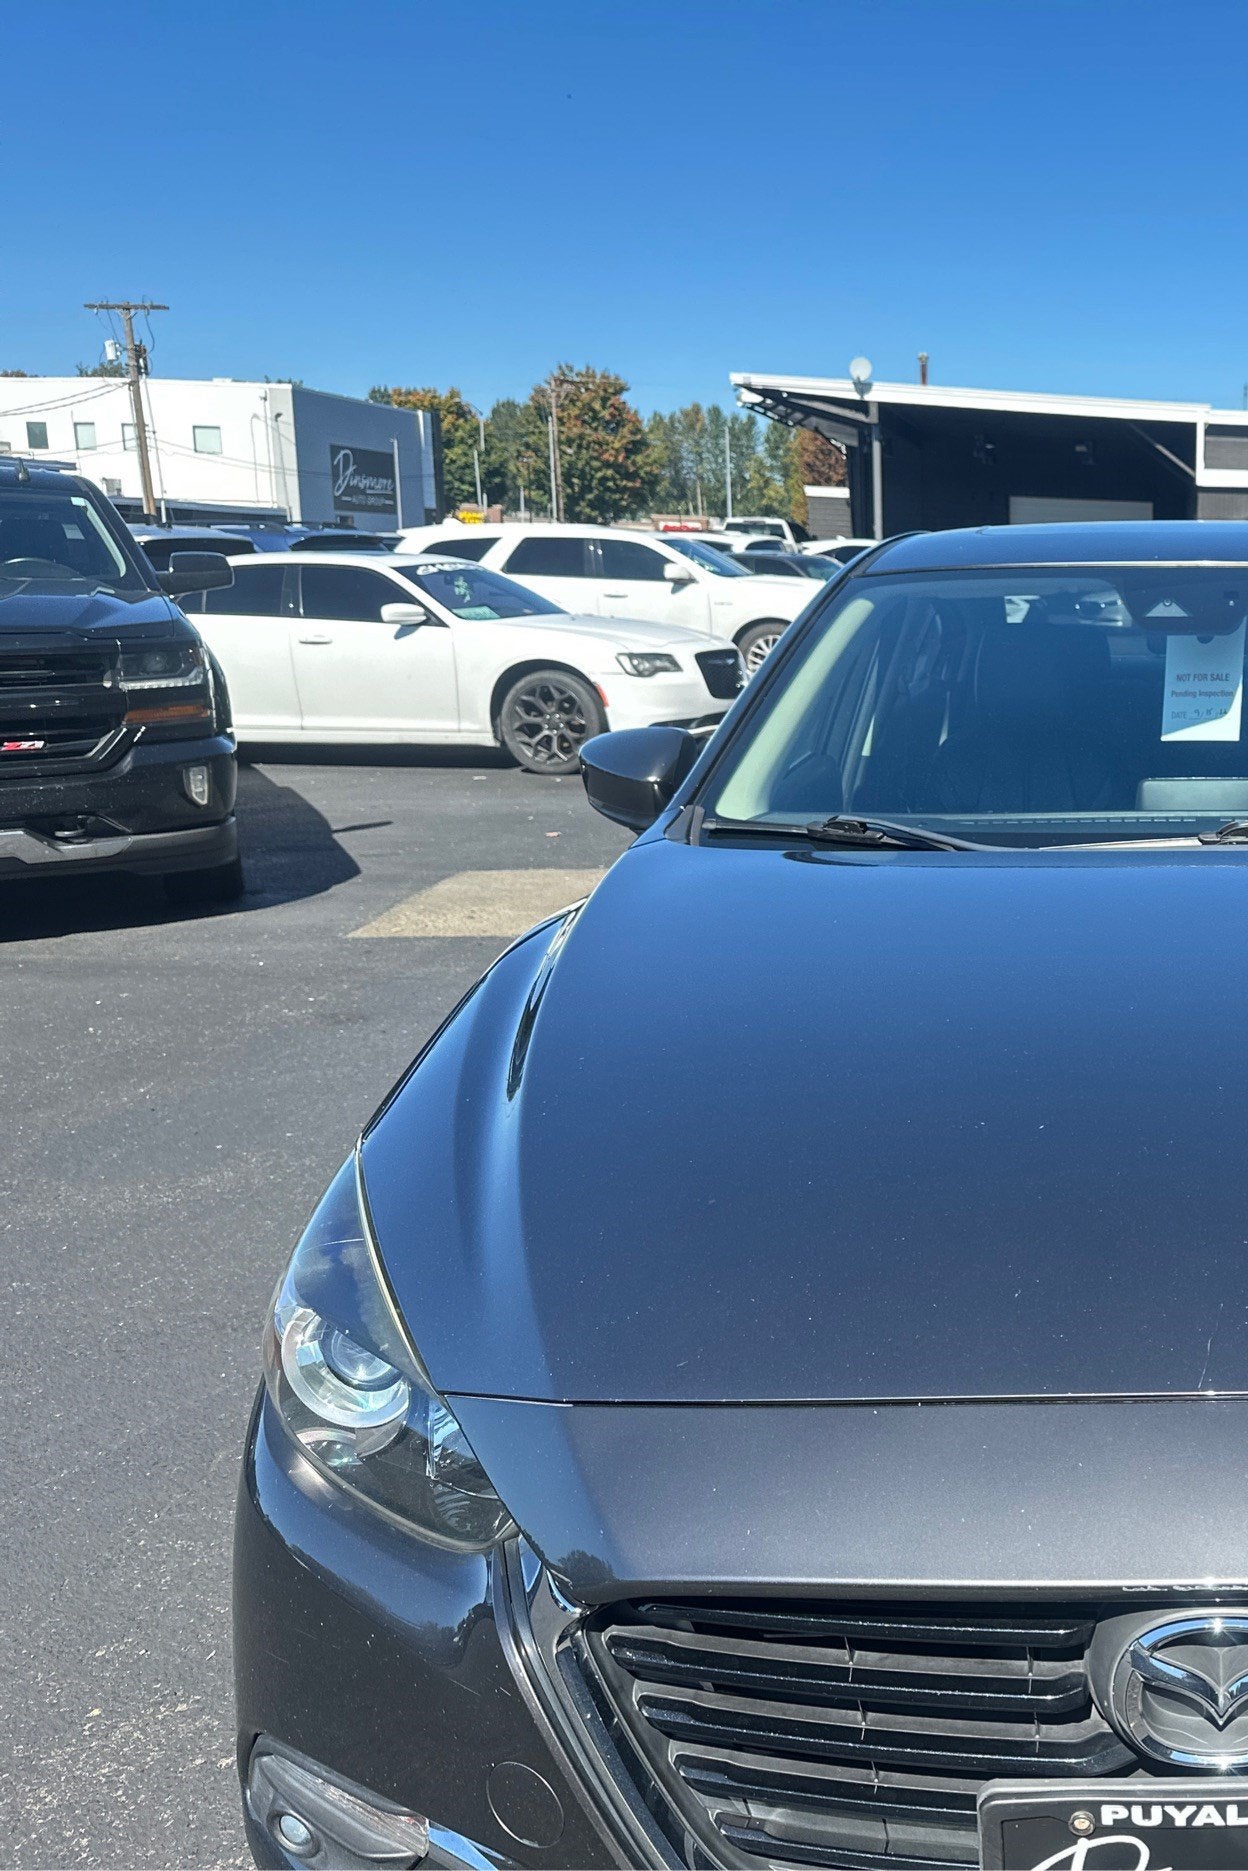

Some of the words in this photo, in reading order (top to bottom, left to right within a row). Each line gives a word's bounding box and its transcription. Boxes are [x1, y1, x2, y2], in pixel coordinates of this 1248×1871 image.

[1176, 673, 1191, 682] NOT
[1193, 673, 1208, 682] FOR
[1210, 673, 1230, 682] SALE
[1171, 690, 1197, 698] Pending
[1198, 690, 1234, 698] Inspection
[1171, 711, 1187, 719] DATE
